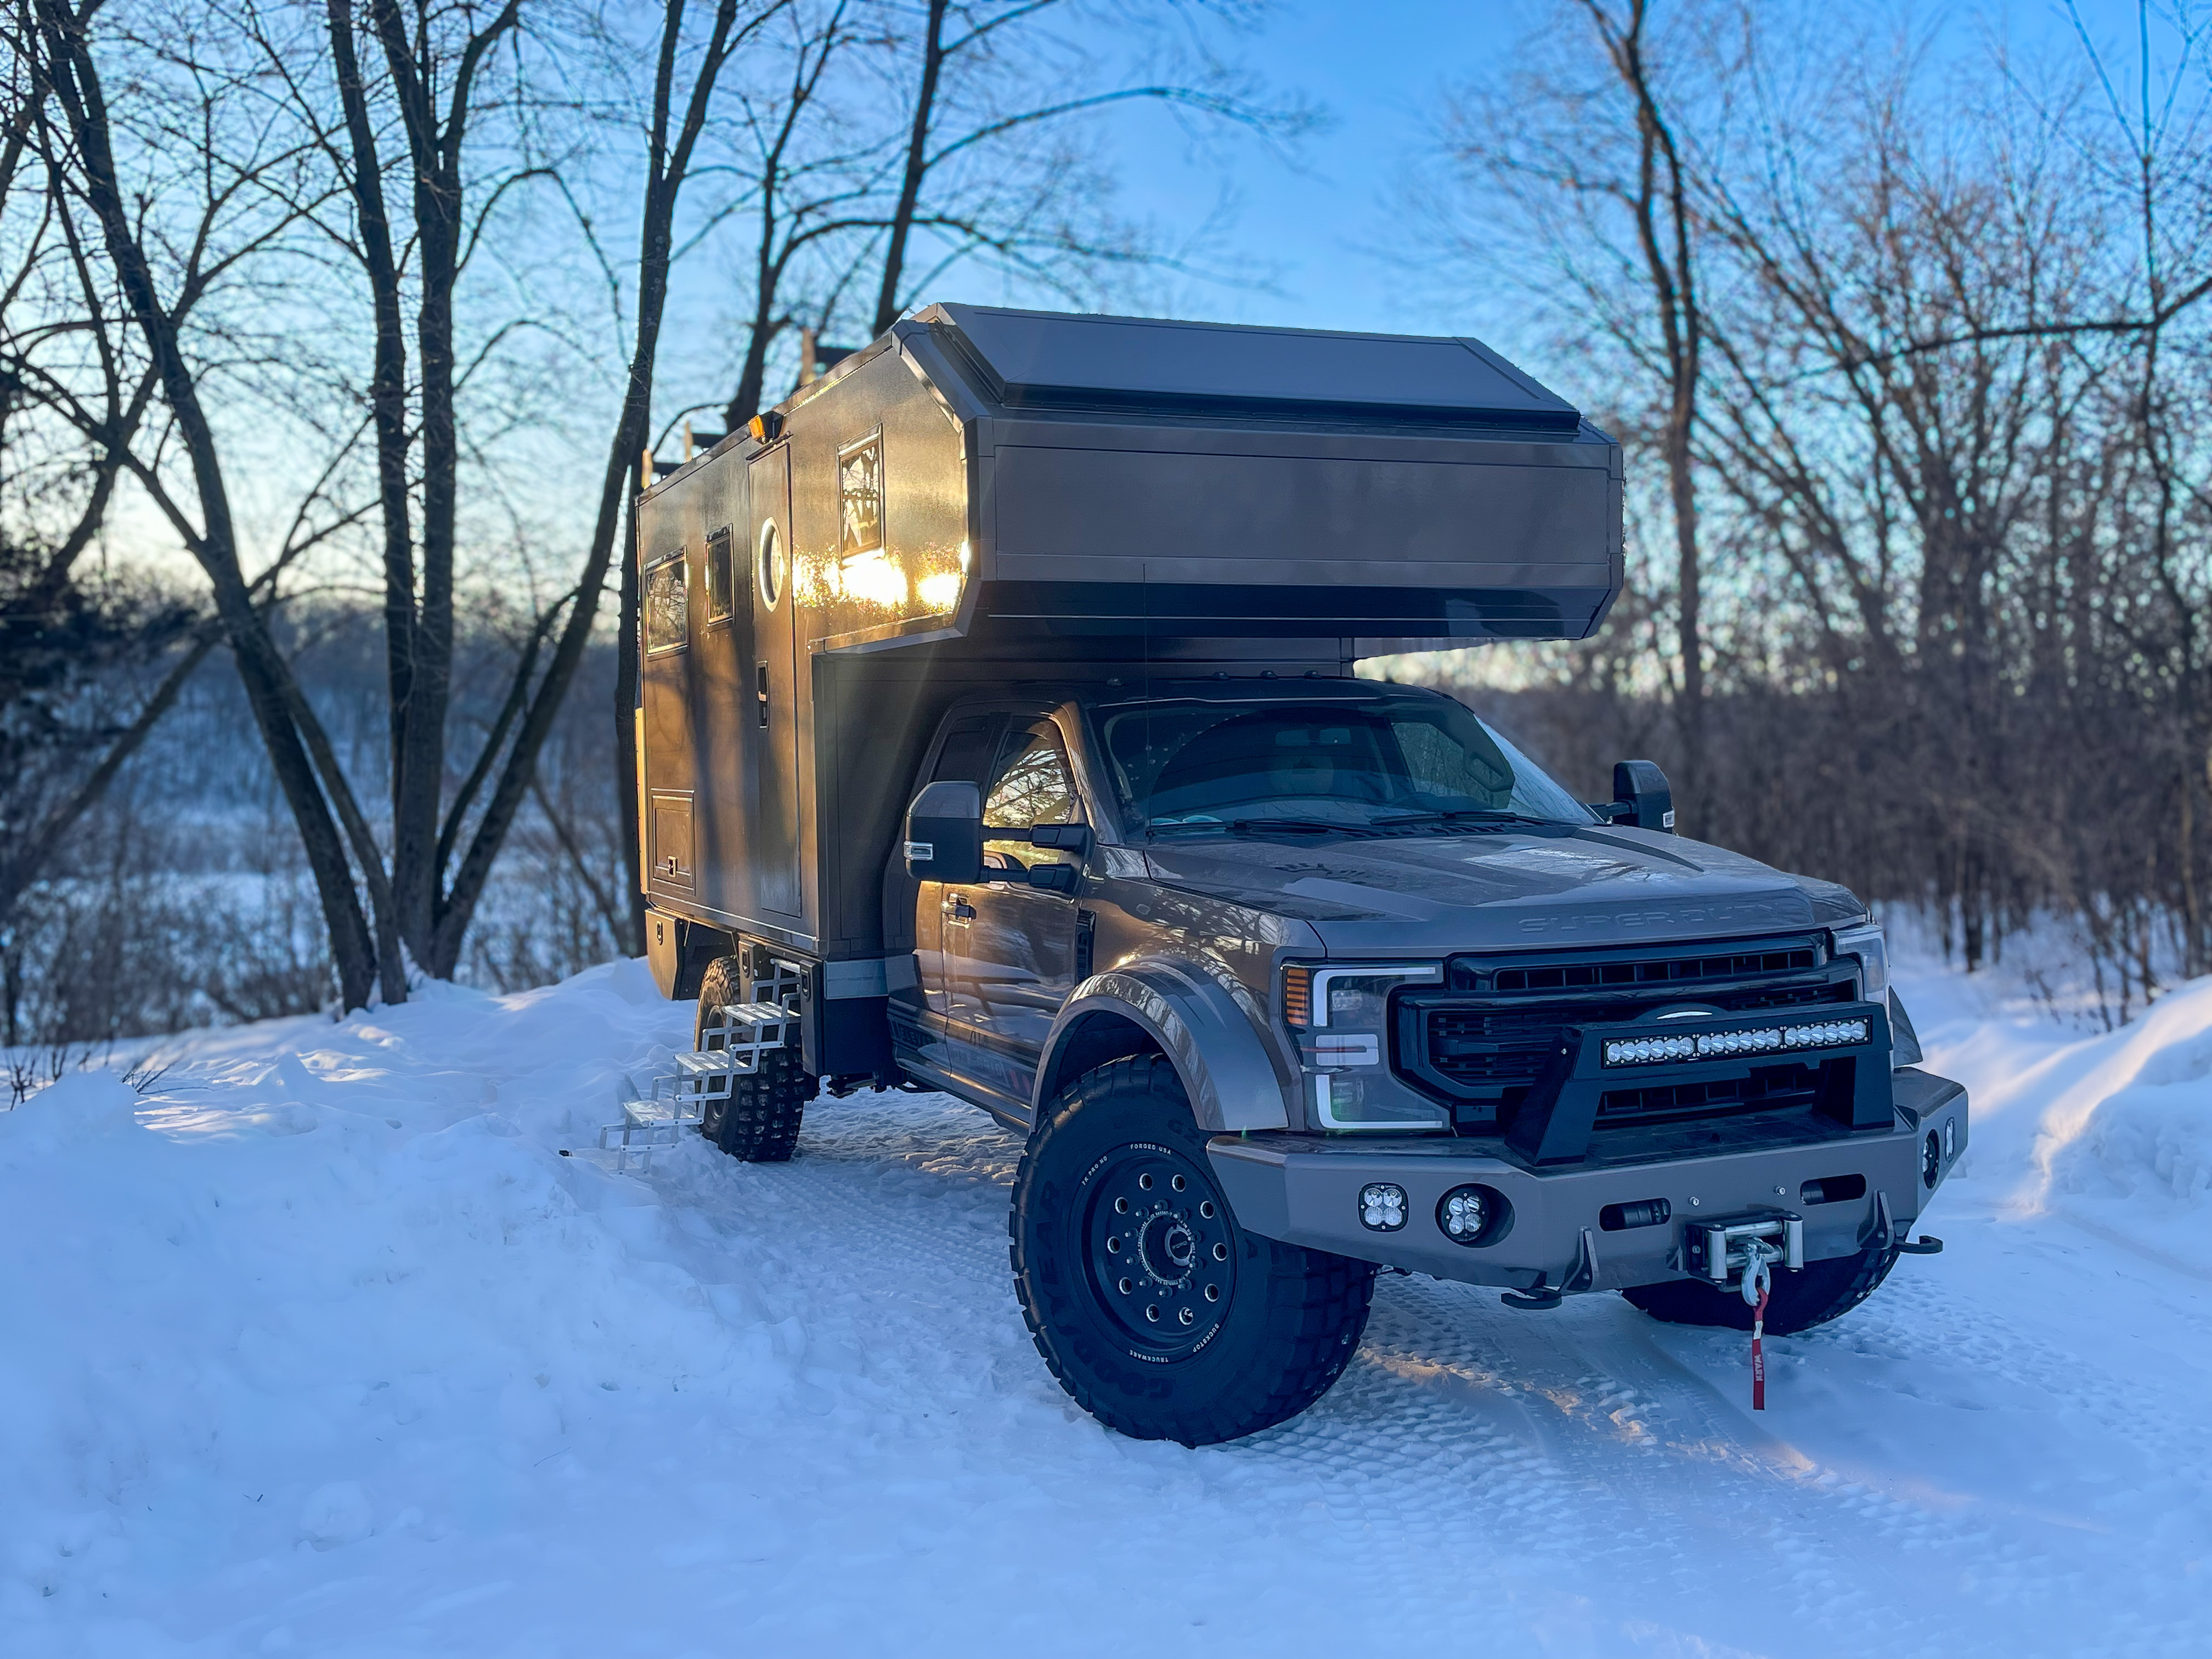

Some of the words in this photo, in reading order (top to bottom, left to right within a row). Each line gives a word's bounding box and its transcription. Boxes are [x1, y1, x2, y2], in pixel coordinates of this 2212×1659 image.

[1519, 912, 1675, 933] SUPER
[1159, 1146, 1172, 1155] USA
[1088, 1163, 1099, 1176] PRO
[1129, 1349, 1169, 1363] TRUCKWARE
